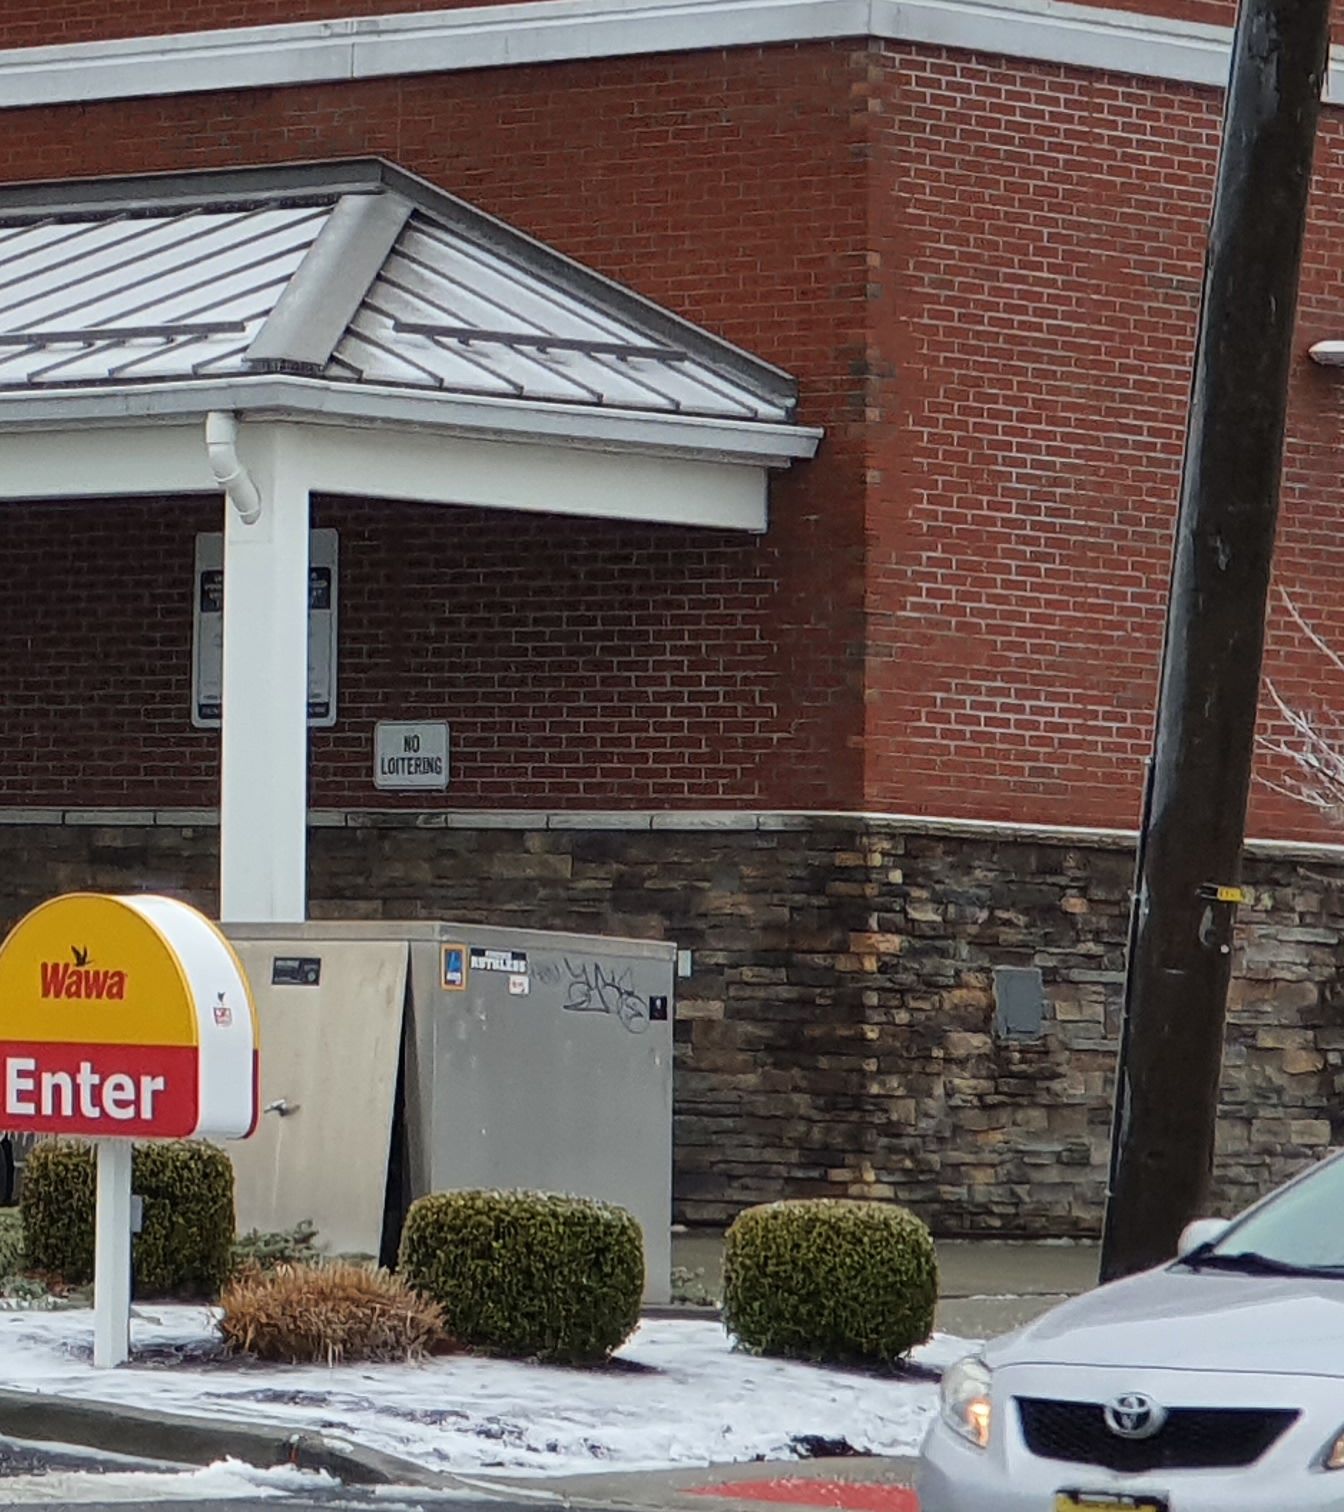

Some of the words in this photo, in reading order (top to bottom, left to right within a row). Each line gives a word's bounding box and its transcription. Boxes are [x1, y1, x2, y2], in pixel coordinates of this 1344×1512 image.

[403, 734, 421, 754] NO
[380, 756, 443, 776] LOITERING
[40, 961, 127, 1001] Wawa
[4, 1056, 166, 1121] Enter
